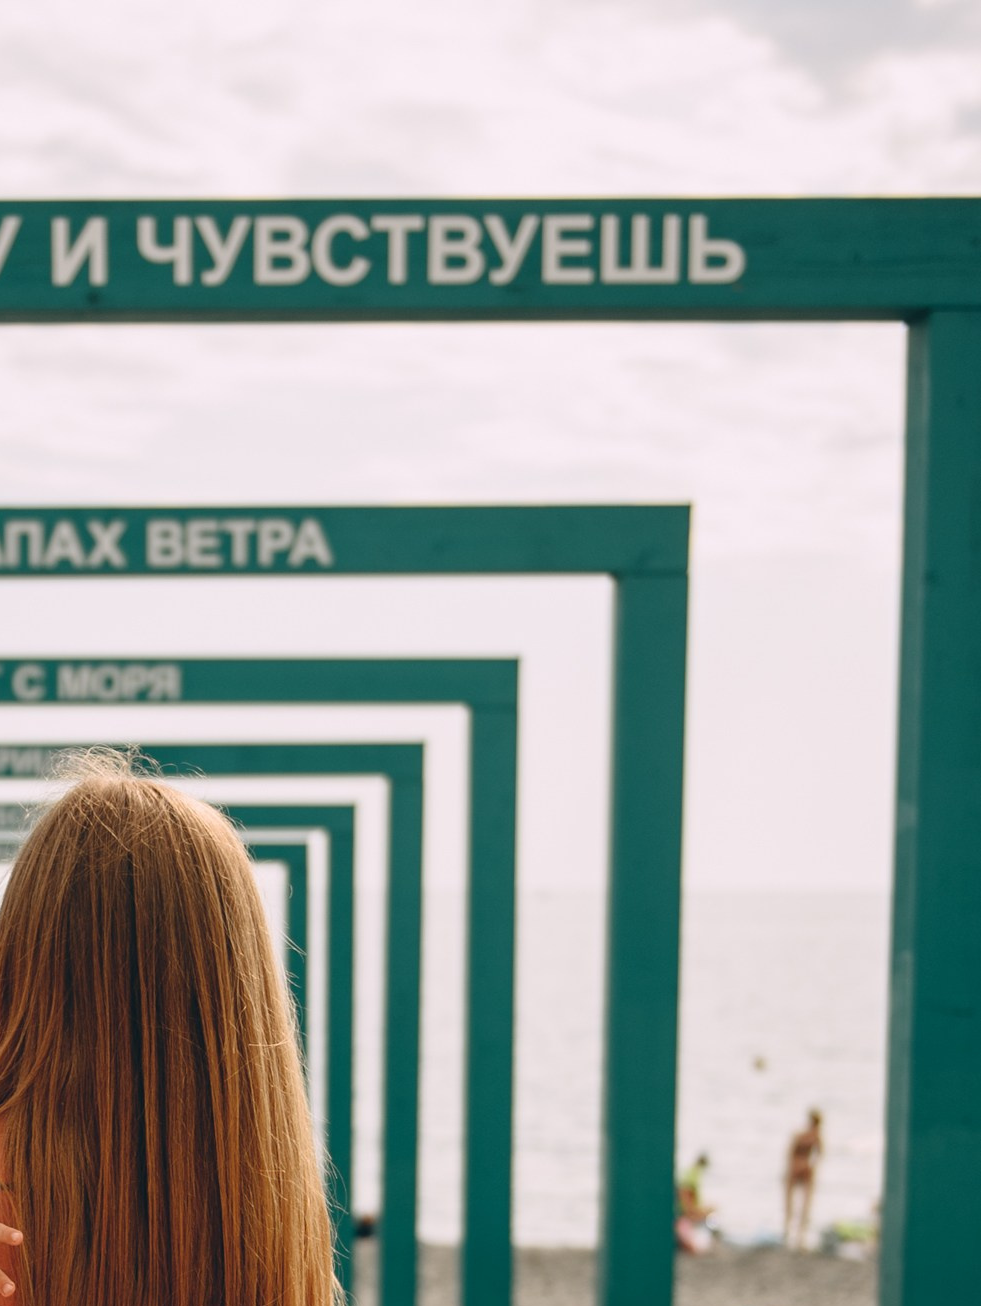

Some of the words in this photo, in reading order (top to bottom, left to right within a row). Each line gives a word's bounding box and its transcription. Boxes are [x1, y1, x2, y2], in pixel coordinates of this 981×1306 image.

[51, 217, 108, 287] И
[136, 214, 747, 287] ЧУВСТВУЕШЬ
[146, 519, 333, 568] ВЕТРА
[11, 664, 45, 699] С
[57, 664, 182, 699] МОРЯ
